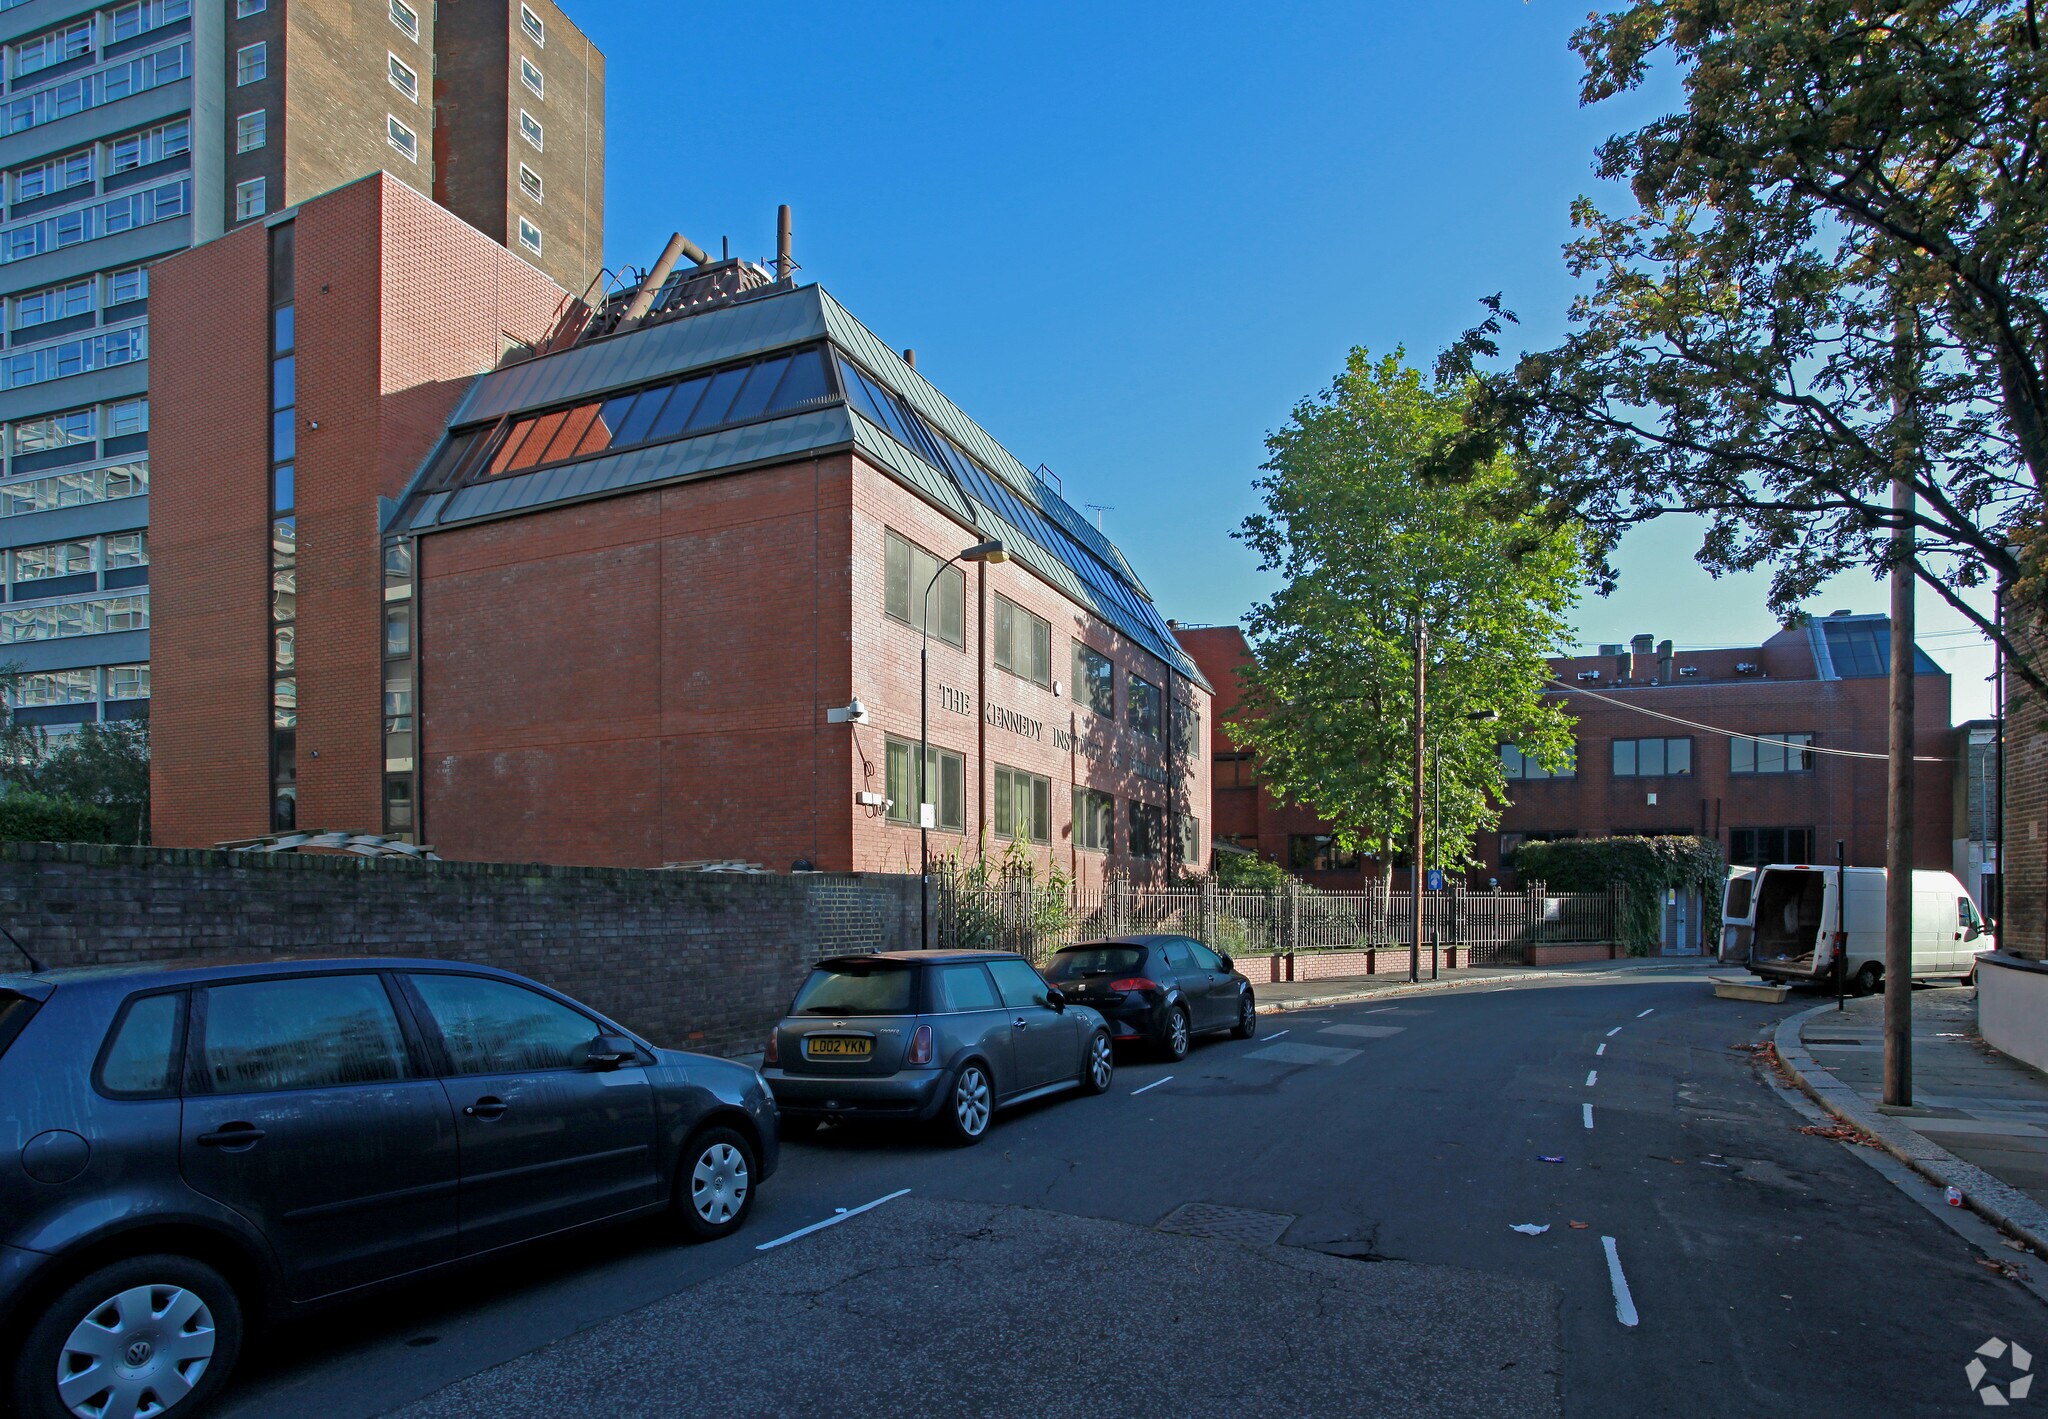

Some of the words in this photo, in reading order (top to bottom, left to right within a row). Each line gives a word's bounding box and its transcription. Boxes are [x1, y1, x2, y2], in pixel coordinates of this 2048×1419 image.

[939, 683, 971, 717] THE
[984, 702, 1043, 742] KENNEDY
[812, 1040, 841, 1053] LO02
[844, 1040, 866, 1053] YKN
